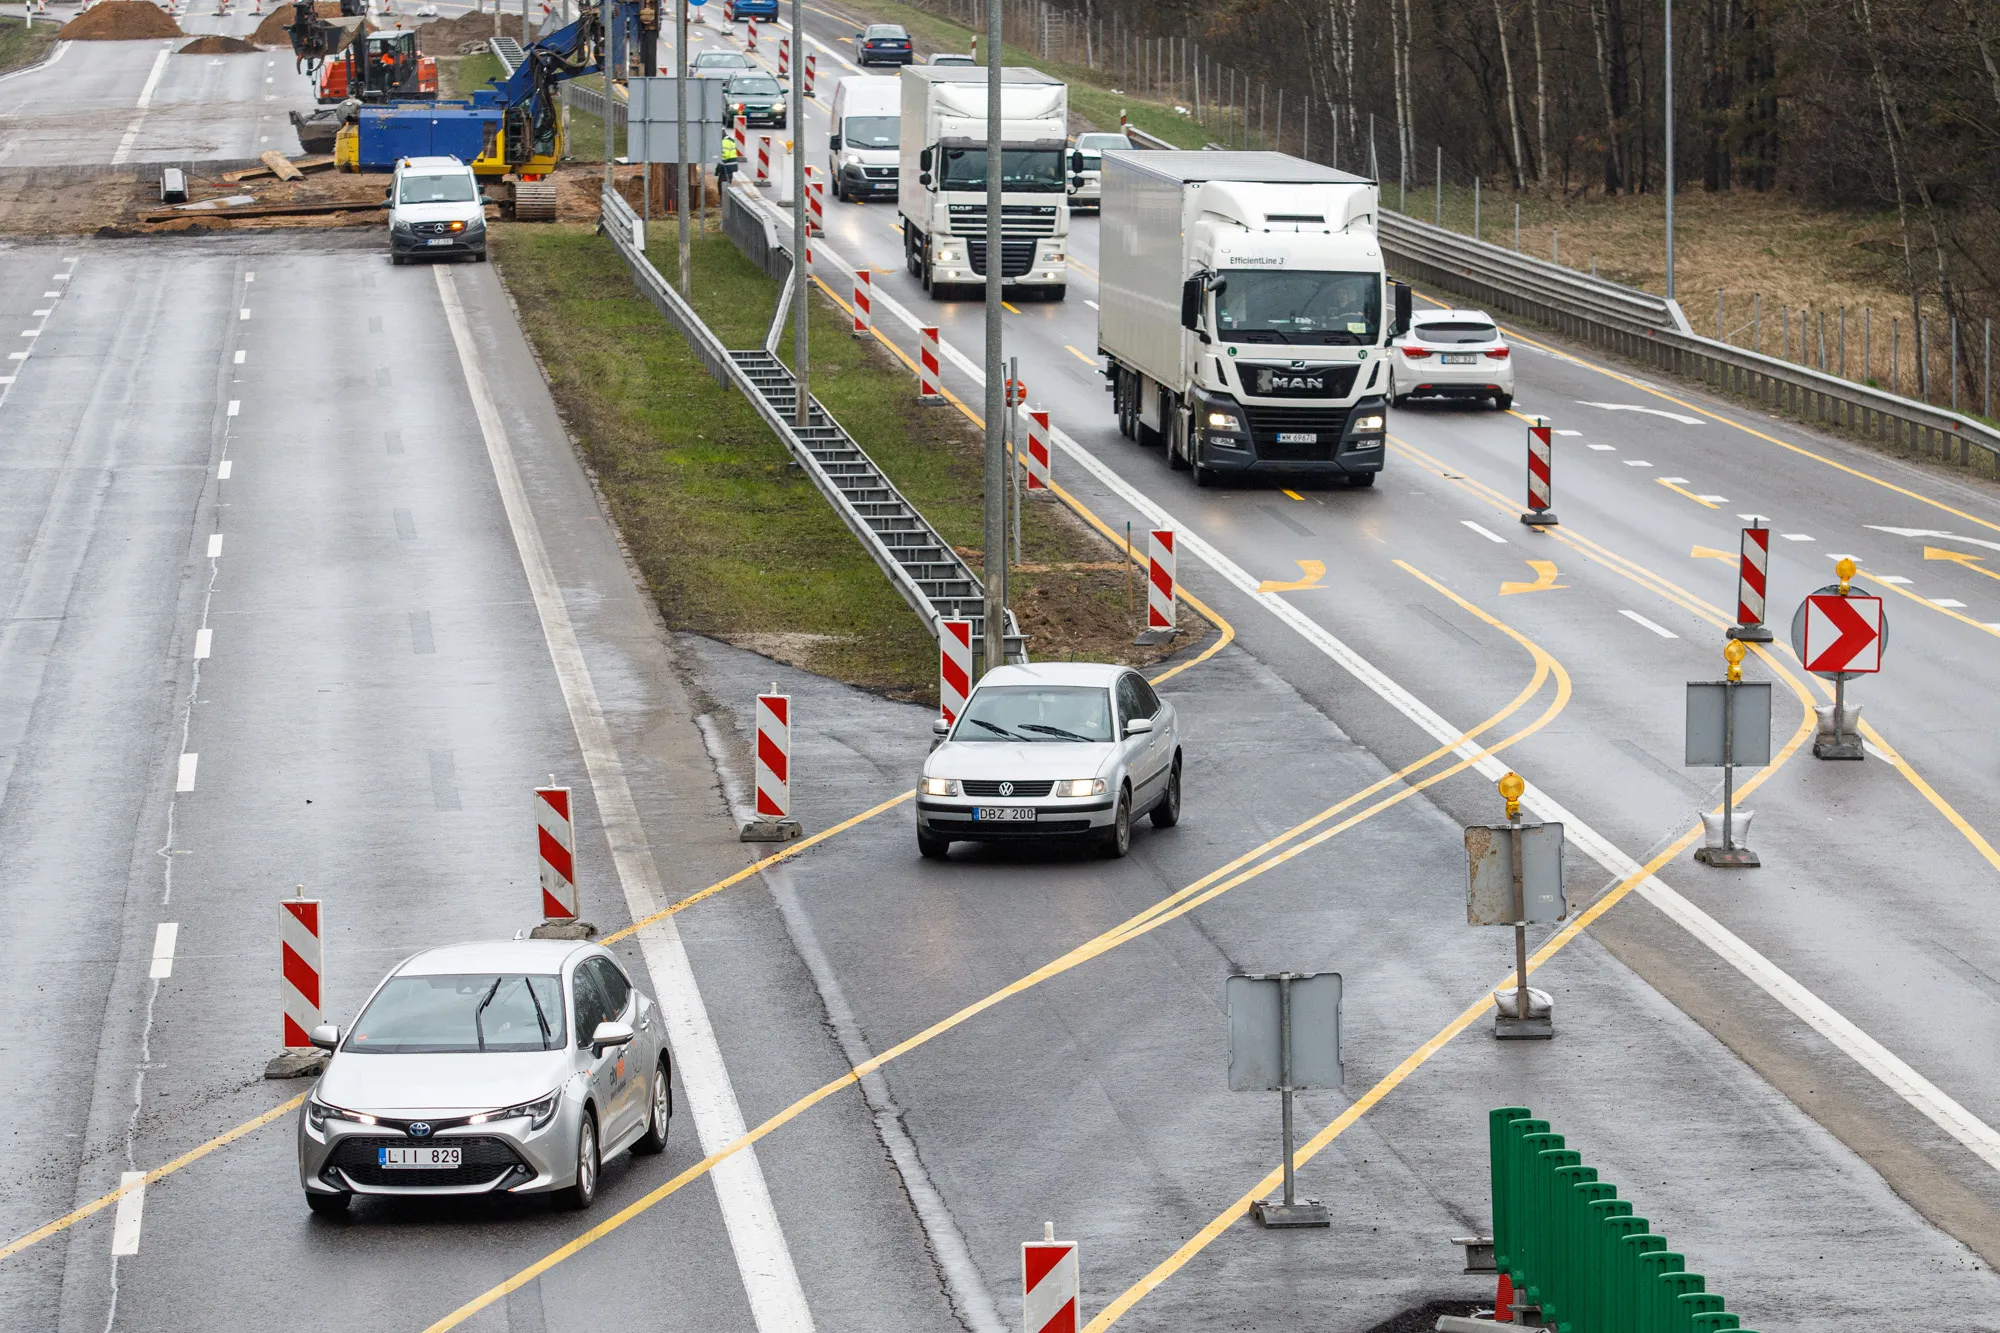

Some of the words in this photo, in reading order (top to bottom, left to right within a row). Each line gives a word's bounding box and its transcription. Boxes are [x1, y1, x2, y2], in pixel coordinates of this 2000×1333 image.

[1230, 256, 1277, 265] EfficientLine
[1278, 257, 1284, 265] 3
[1272, 377, 1323, 389] MAN
[980, 808, 1005, 820] DBZ
[1012, 808, 1034, 820] 200
[388, 1149, 418, 1164] LII
[431, 1149, 460, 1164] 829
